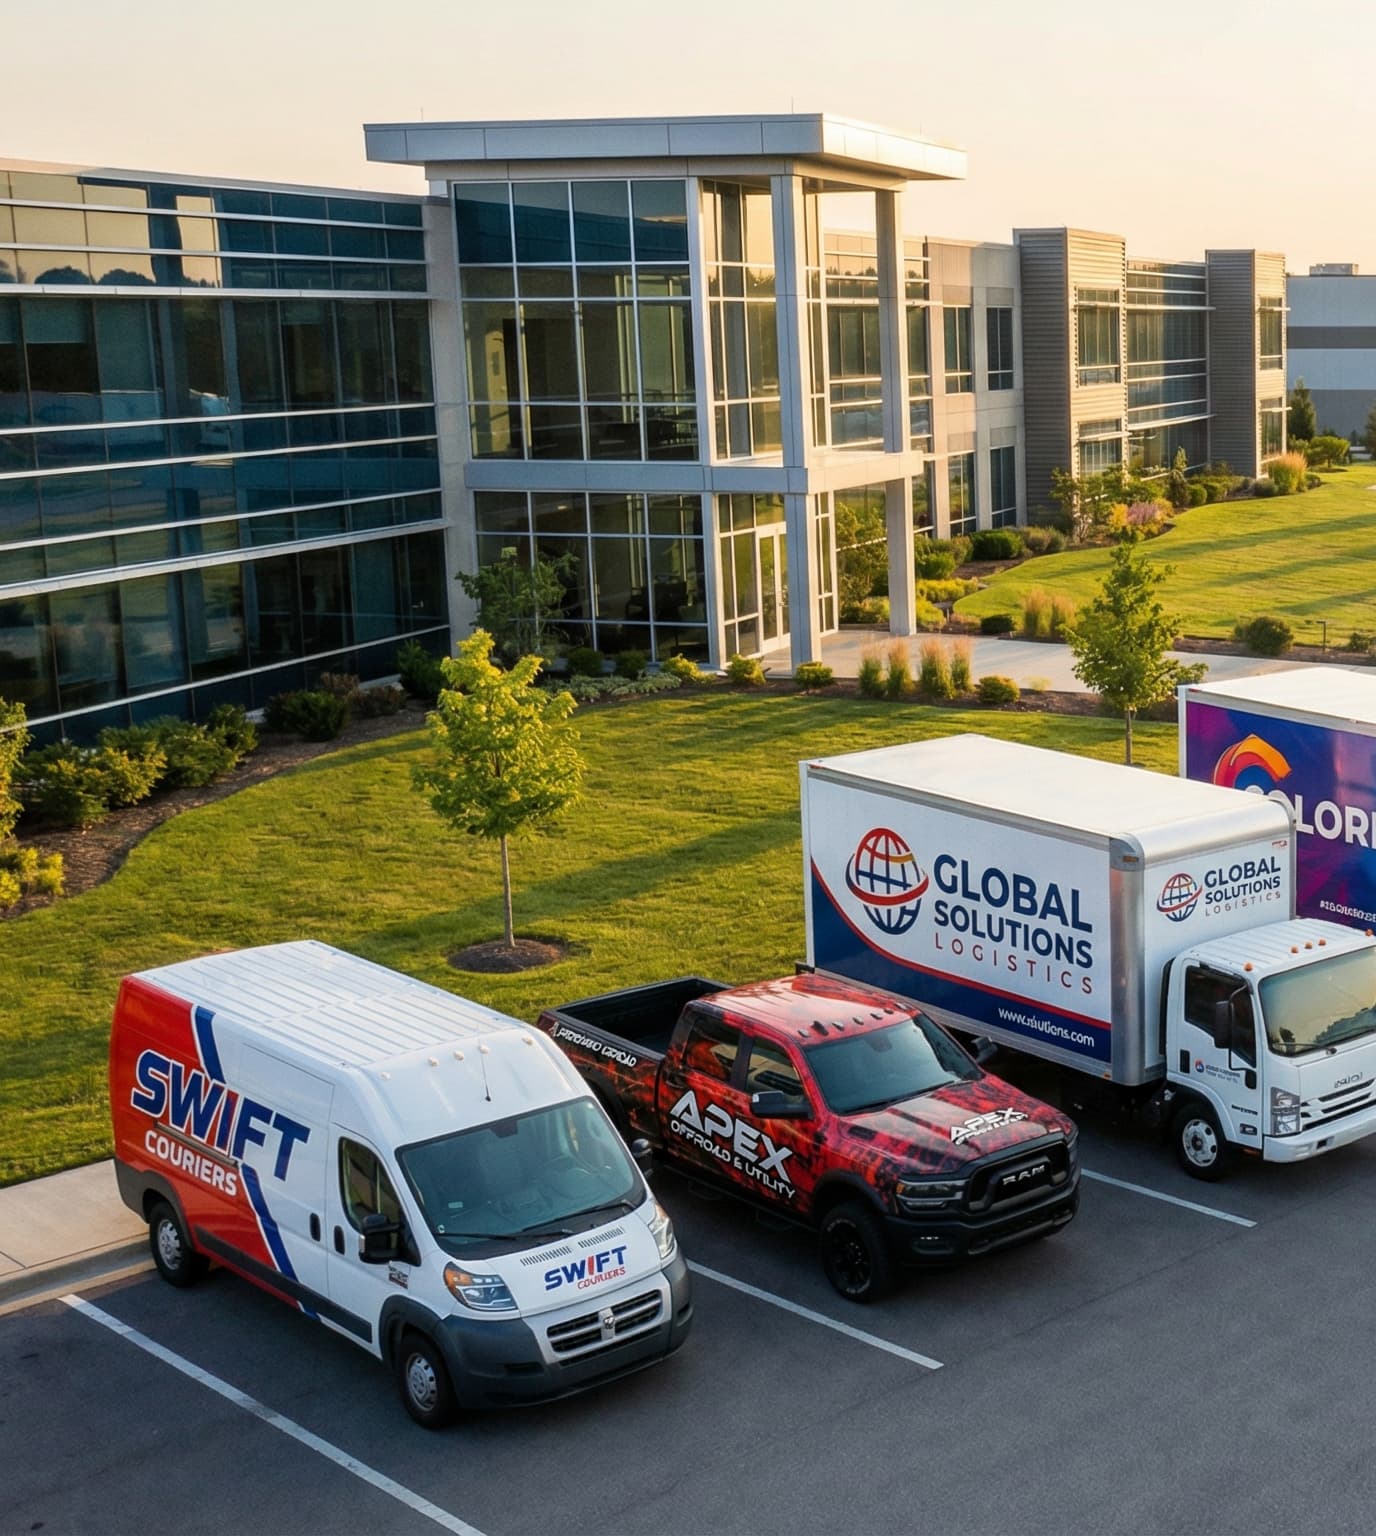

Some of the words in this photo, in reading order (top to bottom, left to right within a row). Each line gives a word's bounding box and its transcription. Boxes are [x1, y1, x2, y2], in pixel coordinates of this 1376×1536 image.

[933, 854, 1093, 933] GLOBAL
[1204, 856, 1281, 888] GLOBAL
[1205, 876, 1281, 905] SOLUTIONS
[934, 899, 1093, 969] SOLUTIONS
[1205, 891, 1281, 916] LOGISTICS
[935, 932, 1093, 994] LOGISTICS
[131, 1049, 311, 1182] SWIFT
[670, 1090, 793, 1184] APEX
[951, 1107, 1024, 1142] APEX
[145, 1130, 238, 1197] COURIERS
[670, 1120, 731, 1162] OFFROAD
[745, 1163, 796, 1199] UTILITY
[1002, 1164, 1045, 1186] RAM
[544, 1246, 627, 1291] SWIFT
